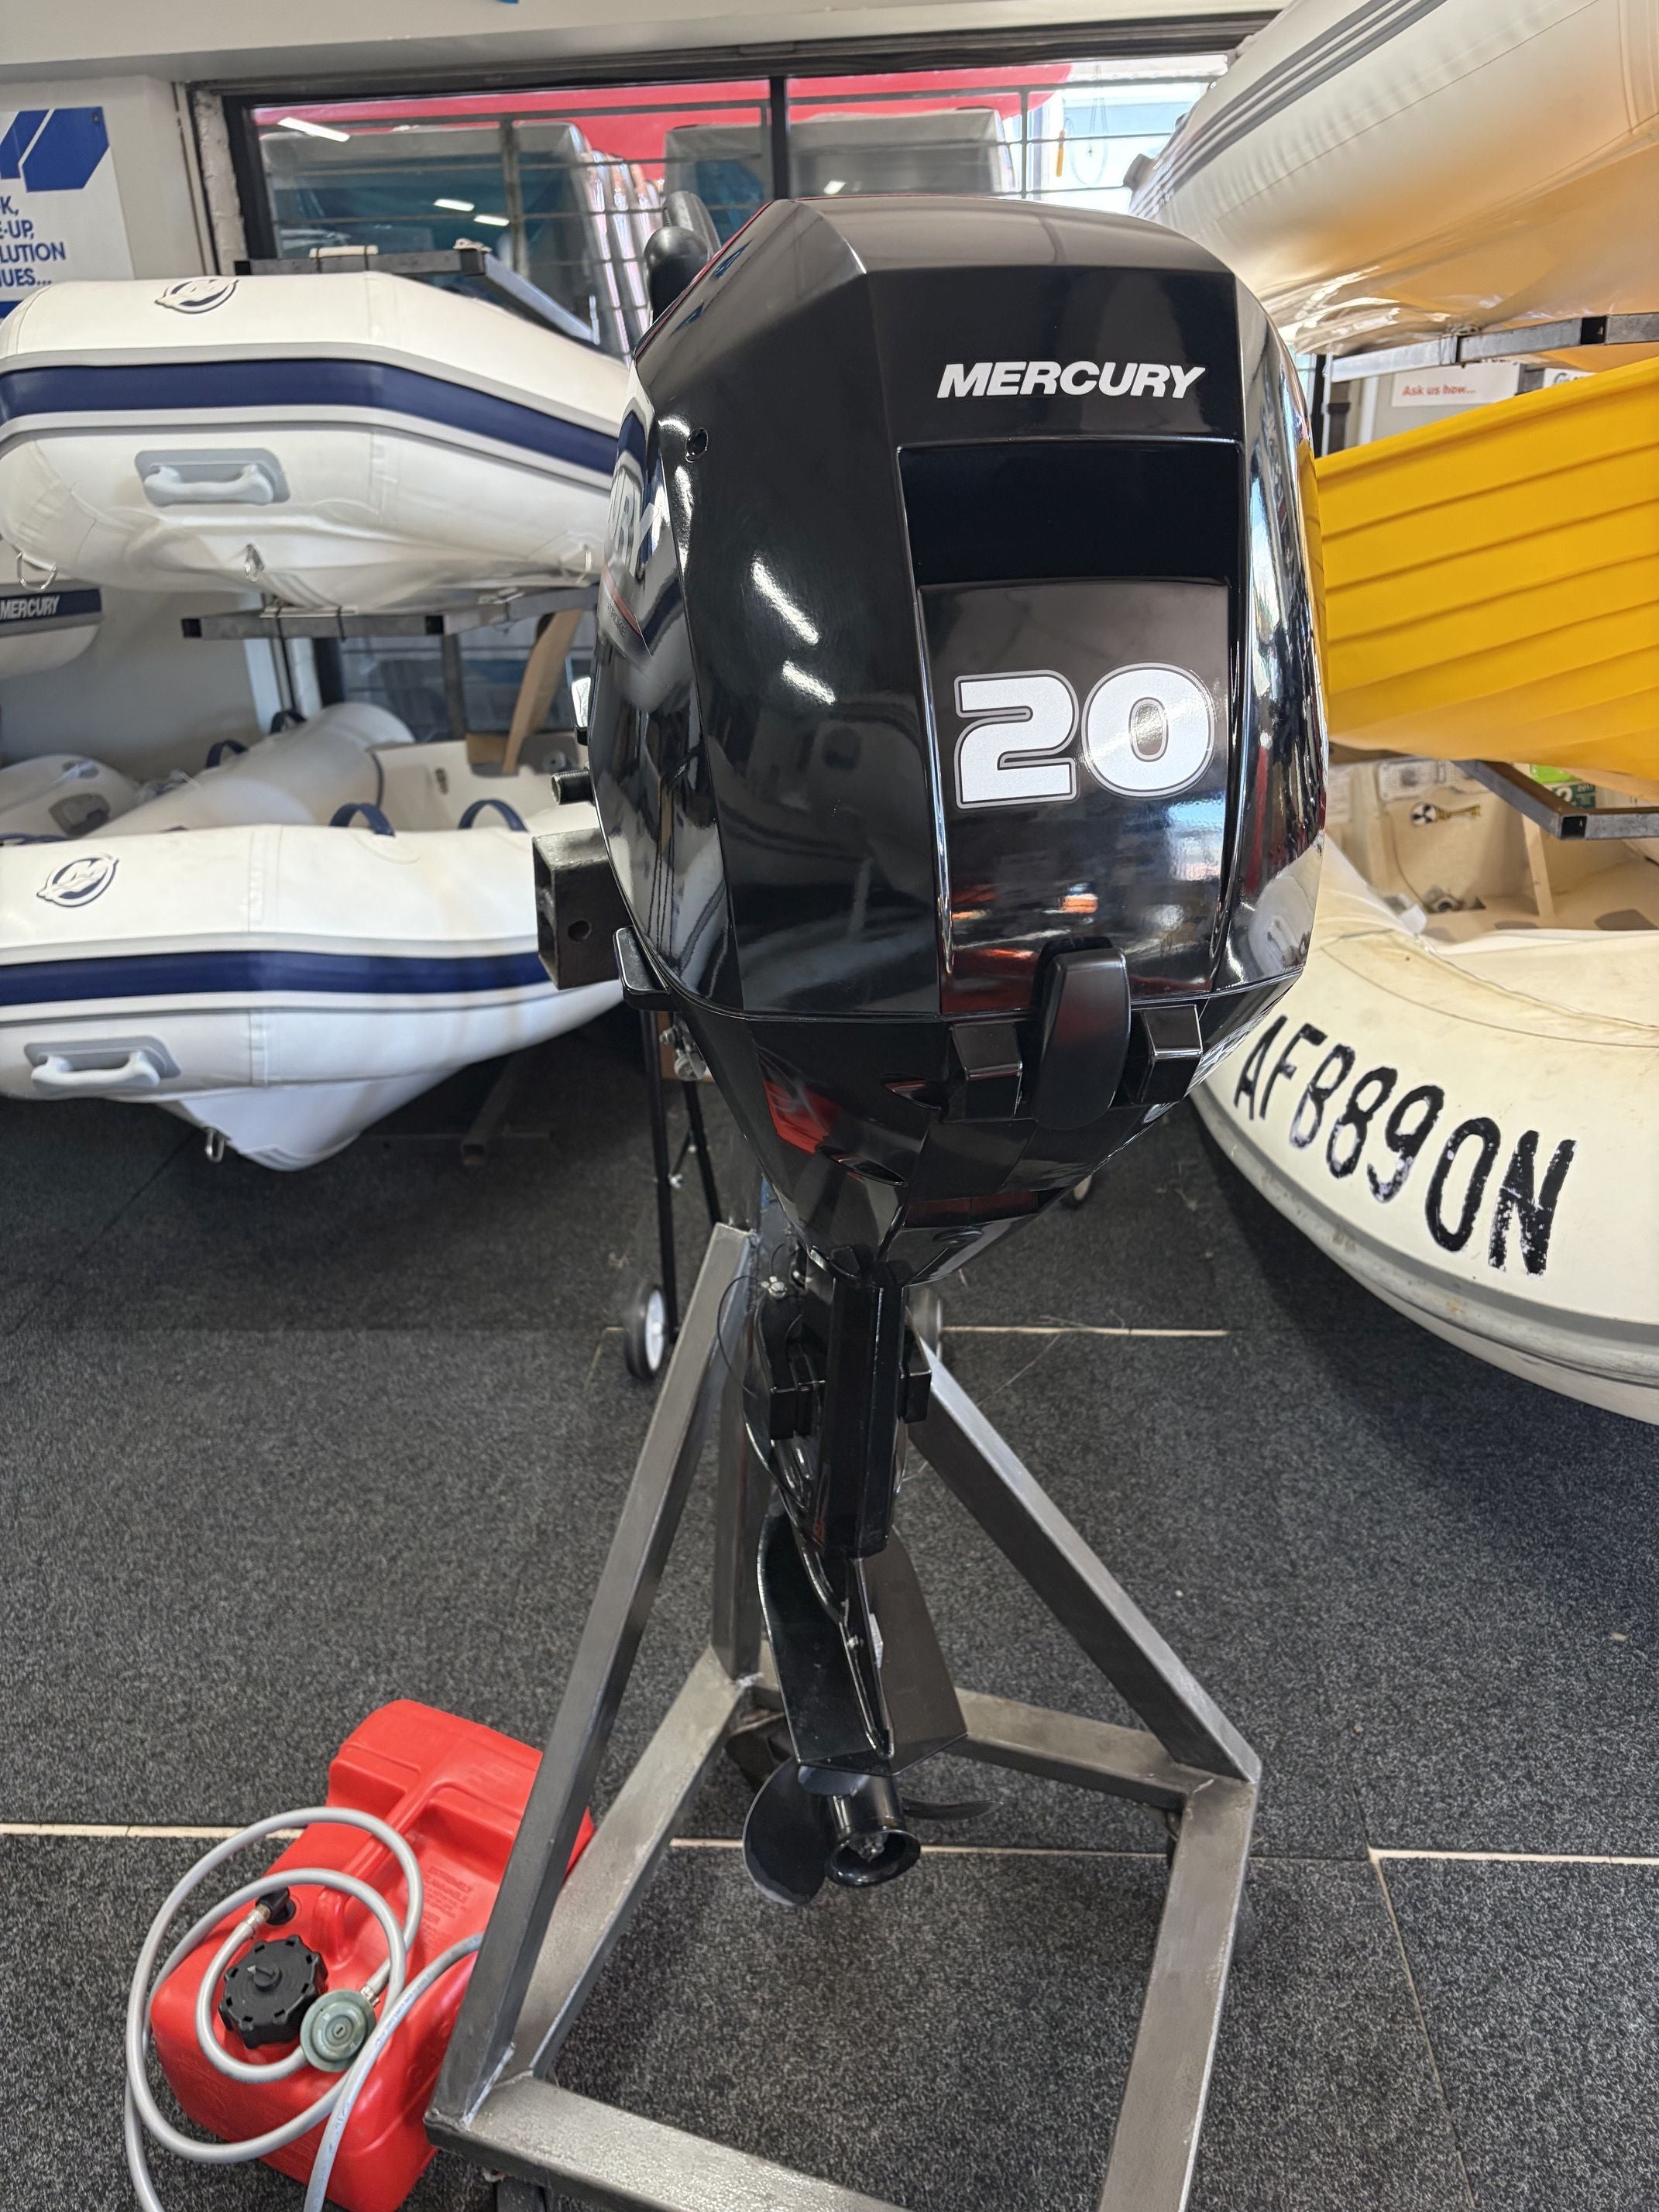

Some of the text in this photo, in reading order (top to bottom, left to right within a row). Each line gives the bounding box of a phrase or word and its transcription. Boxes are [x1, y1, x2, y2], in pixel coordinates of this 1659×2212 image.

[936, 361, 1206, 399] MERCURY
[1402, 386, 1424, 396] Ask
[1426, 386, 1441, 395] us
[0, 595, 60, 620] MERCURY
[953, 662, 1216, 809] 20
